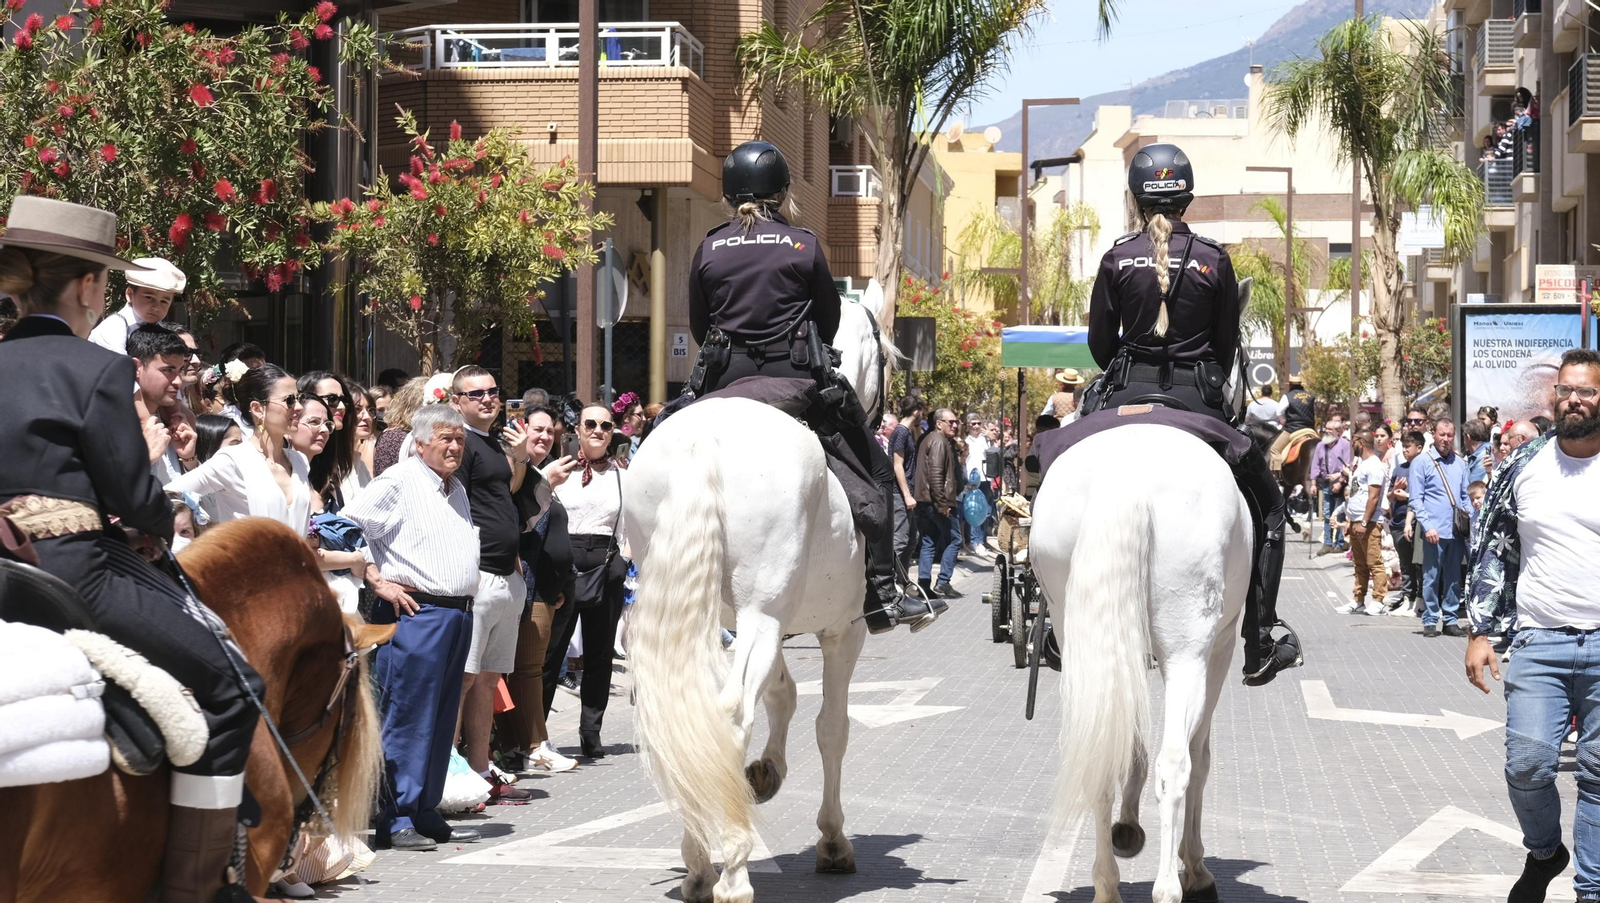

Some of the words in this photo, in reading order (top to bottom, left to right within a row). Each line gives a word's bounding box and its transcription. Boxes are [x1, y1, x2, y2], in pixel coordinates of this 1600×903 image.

[712, 234, 793, 251] POLICIA
[1118, 256, 1201, 271] POLCA
[1473, 338, 1513, 348] NUESTRA
[1514, 338, 1574, 348] INDIFERENCIA
[673, 348, 687, 356] BIS
[1473, 349, 1490, 358] LOS
[1491, 349, 1532, 358] CONDENA
[1473, 360, 1484, 369] AL
[1485, 360, 1518, 369] OLVIDO
